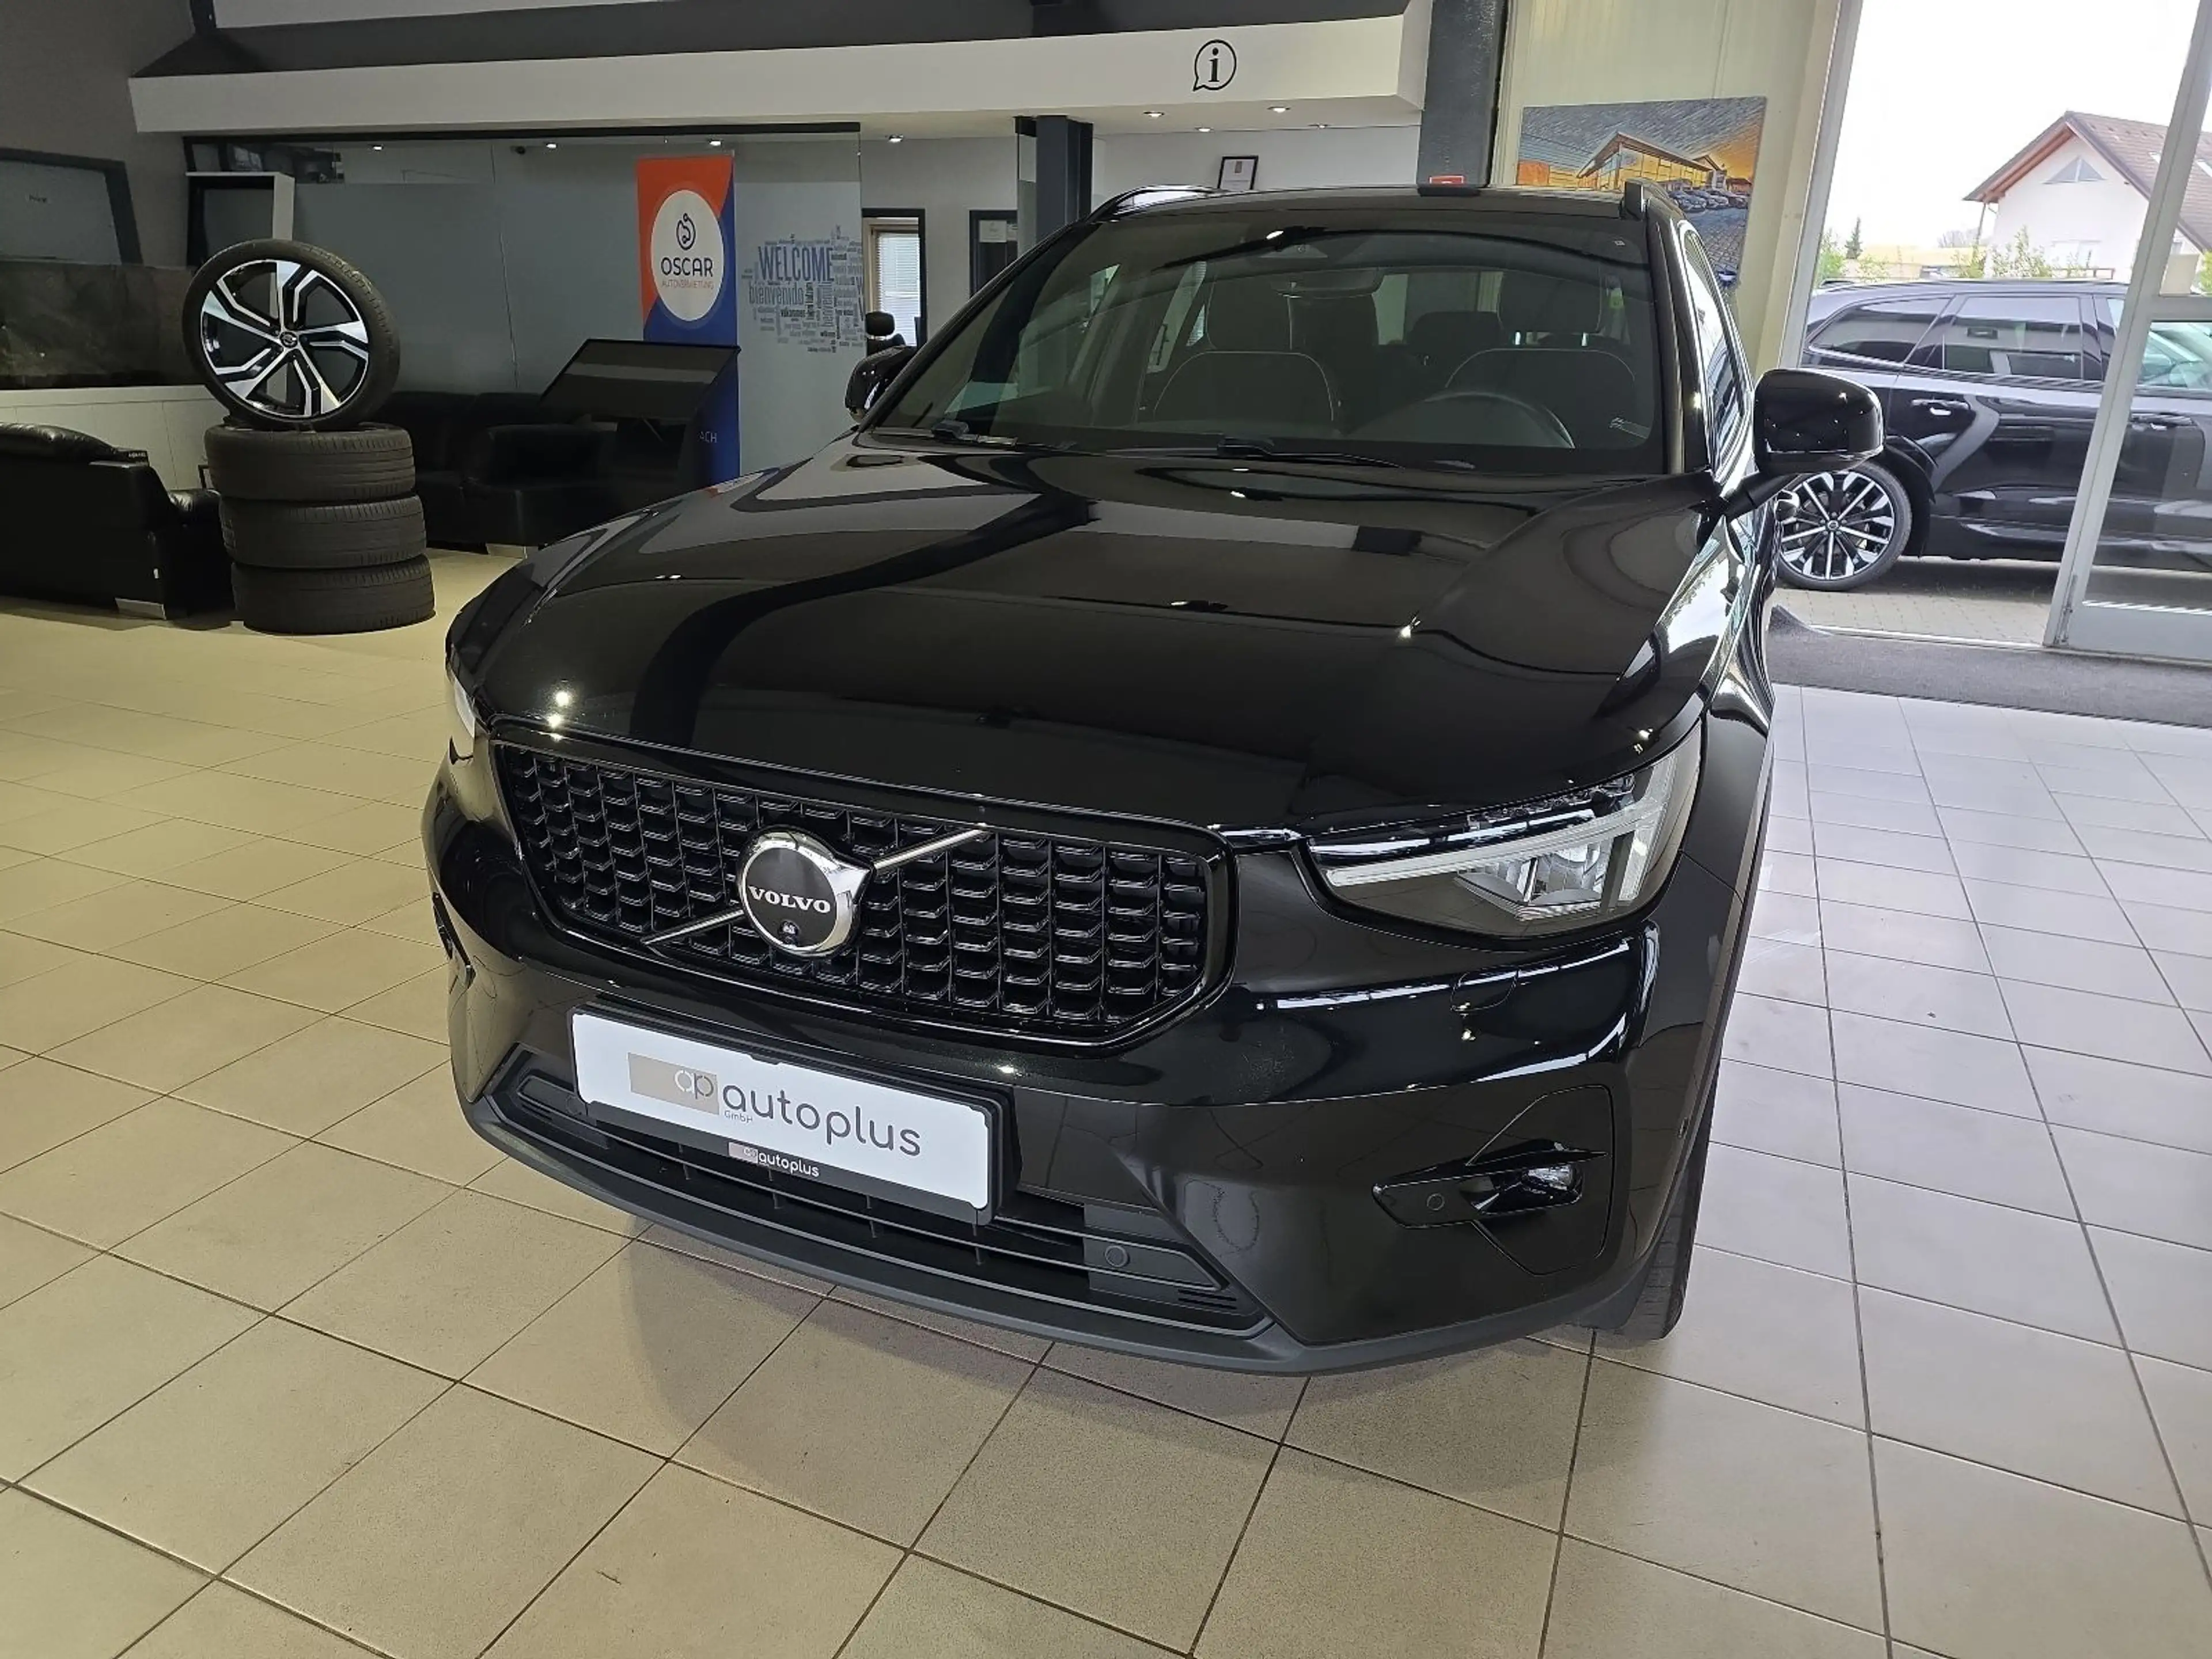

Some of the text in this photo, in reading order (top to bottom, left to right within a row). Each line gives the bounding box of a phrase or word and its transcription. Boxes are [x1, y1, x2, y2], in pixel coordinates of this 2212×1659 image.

[661, 257, 713, 276] OSCAR
[758, 246, 835, 281] WELCOME
[749, 886, 831, 914] VOLVO
[723, 1085, 921, 1156] autoplus
[724, 1110, 753, 1123] GmbH
[759, 1152, 820, 1177] autoplus
